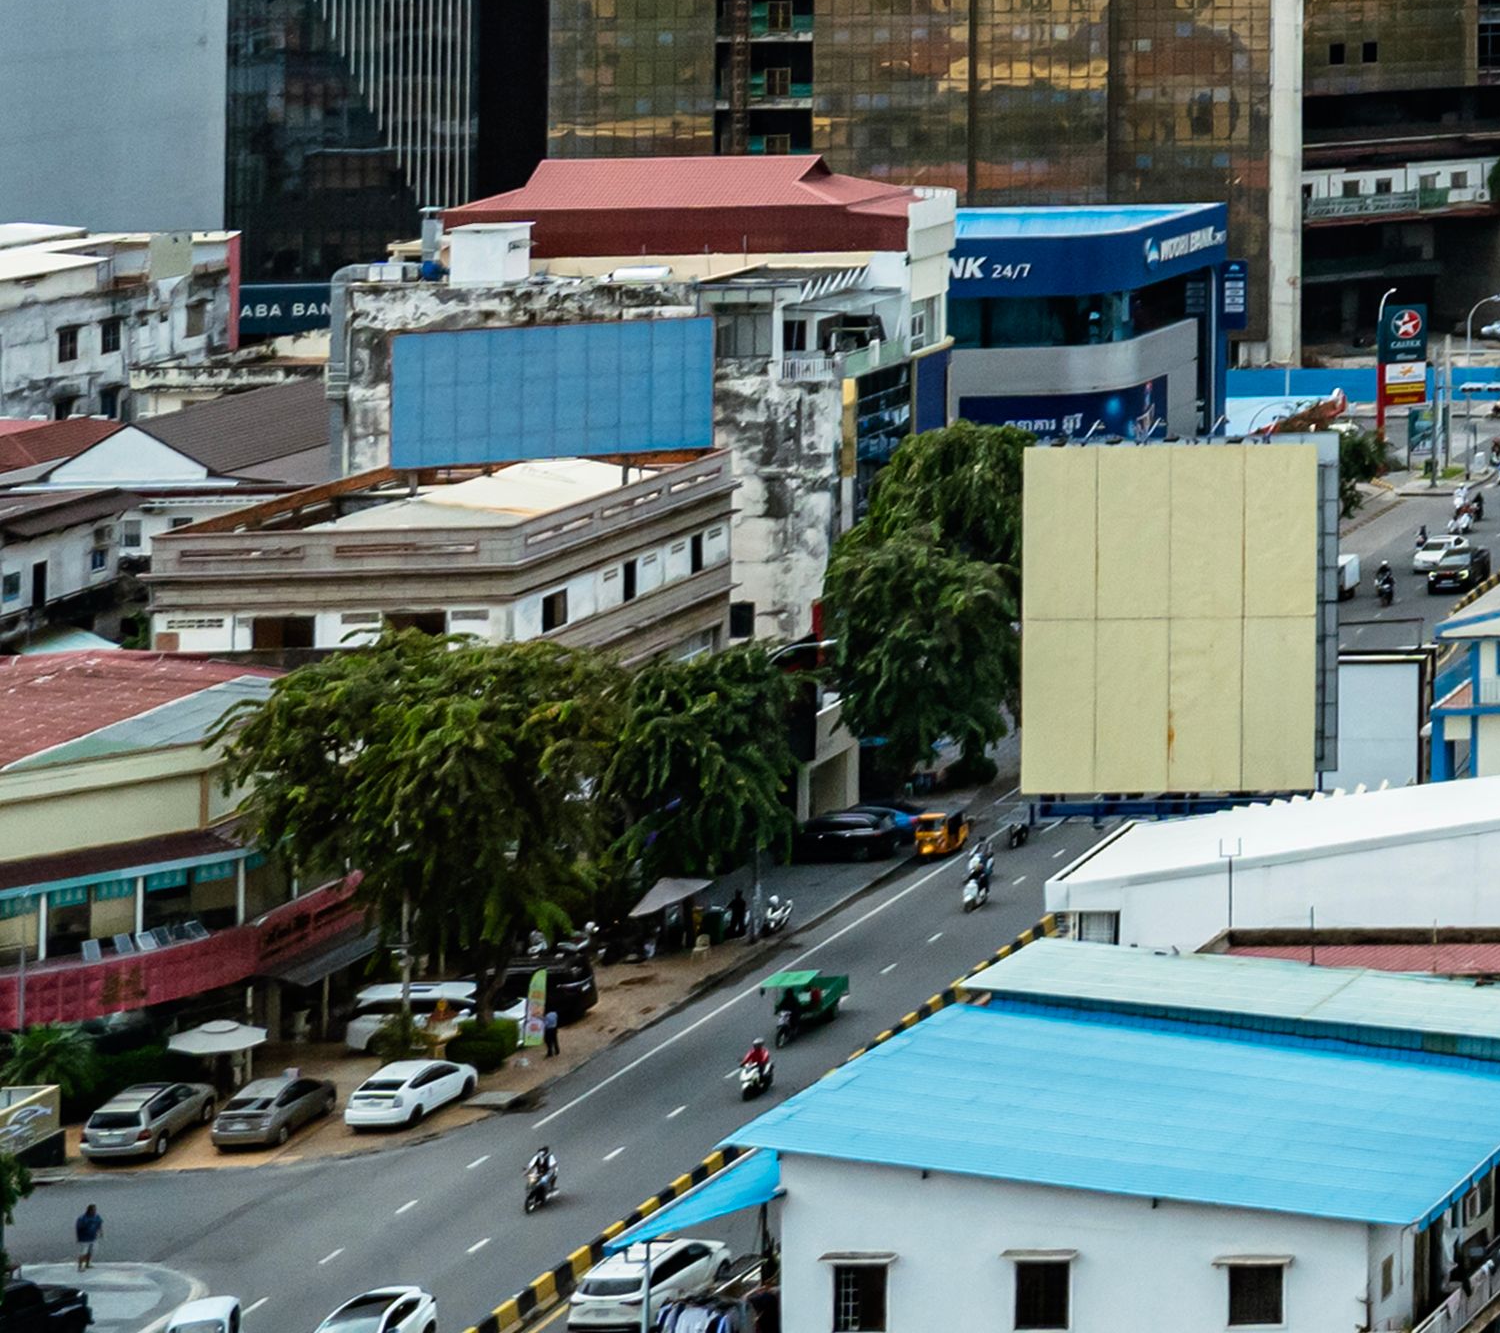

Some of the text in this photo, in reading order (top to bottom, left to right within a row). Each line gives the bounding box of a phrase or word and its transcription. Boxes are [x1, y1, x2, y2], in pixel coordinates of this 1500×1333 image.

[992, 263, 1032, 279] 24/7
[241, 303, 331, 317] ABA BAN
